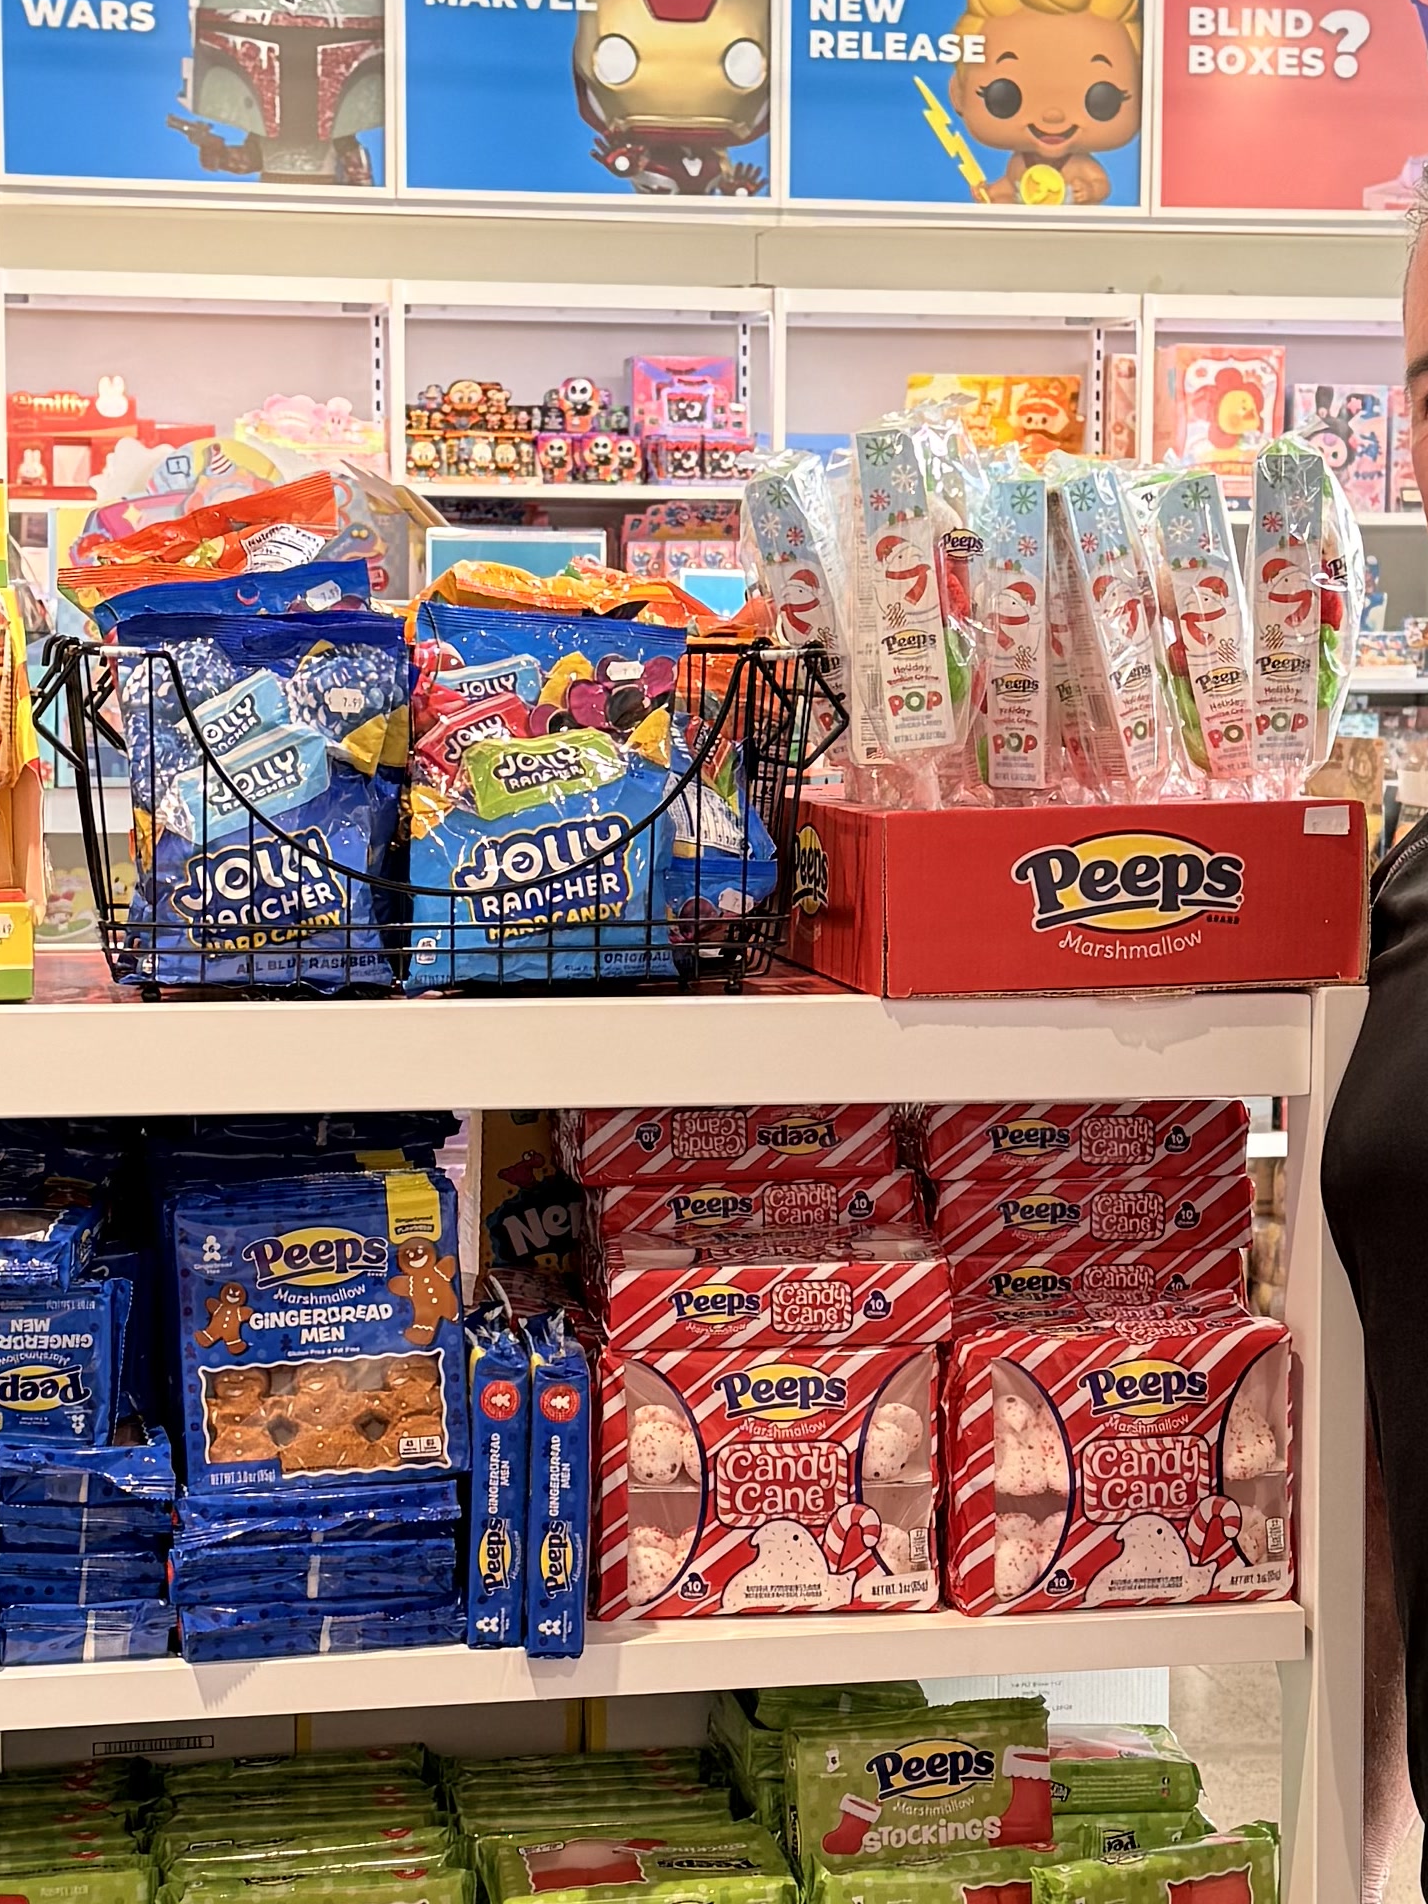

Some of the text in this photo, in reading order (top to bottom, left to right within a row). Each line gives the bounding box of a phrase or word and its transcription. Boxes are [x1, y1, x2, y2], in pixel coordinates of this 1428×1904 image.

[1188, 6, 1313, 39] BLIND
[808, 28, 987, 65] RELEASE
[1016, 847, 1244, 922] Peeps
[1058, 929, 1203, 960] Marshmallow
[987, 1122, 1070, 1154] Peeps
[669, 1194, 753, 1226] Peeps
[998, 1200, 1081, 1233] Peeps
[243, 1238, 388, 1288] Peeps
[273, 1284, 366, 1306] Marshmallow
[670, 1292, 761, 1324] Peeps
[775, 1285, 849, 1312] Candy
[10, 1317, 51, 1333] MEN
[300, 1326, 346, 1345] MEN
[714, 1370, 848, 1418] Peeps
[1079, 1368, 1208, 1416] Peeps
[739, 1417, 827, 1439] Marshmallow
[726, 1444, 840, 1484] Candy
[1091, 1440, 1203, 1480] Candy
[734, 1478, 826, 1517] Cane
[1098, 1476, 1190, 1514] Cane
[866, 1745, 996, 1798] Peeps
